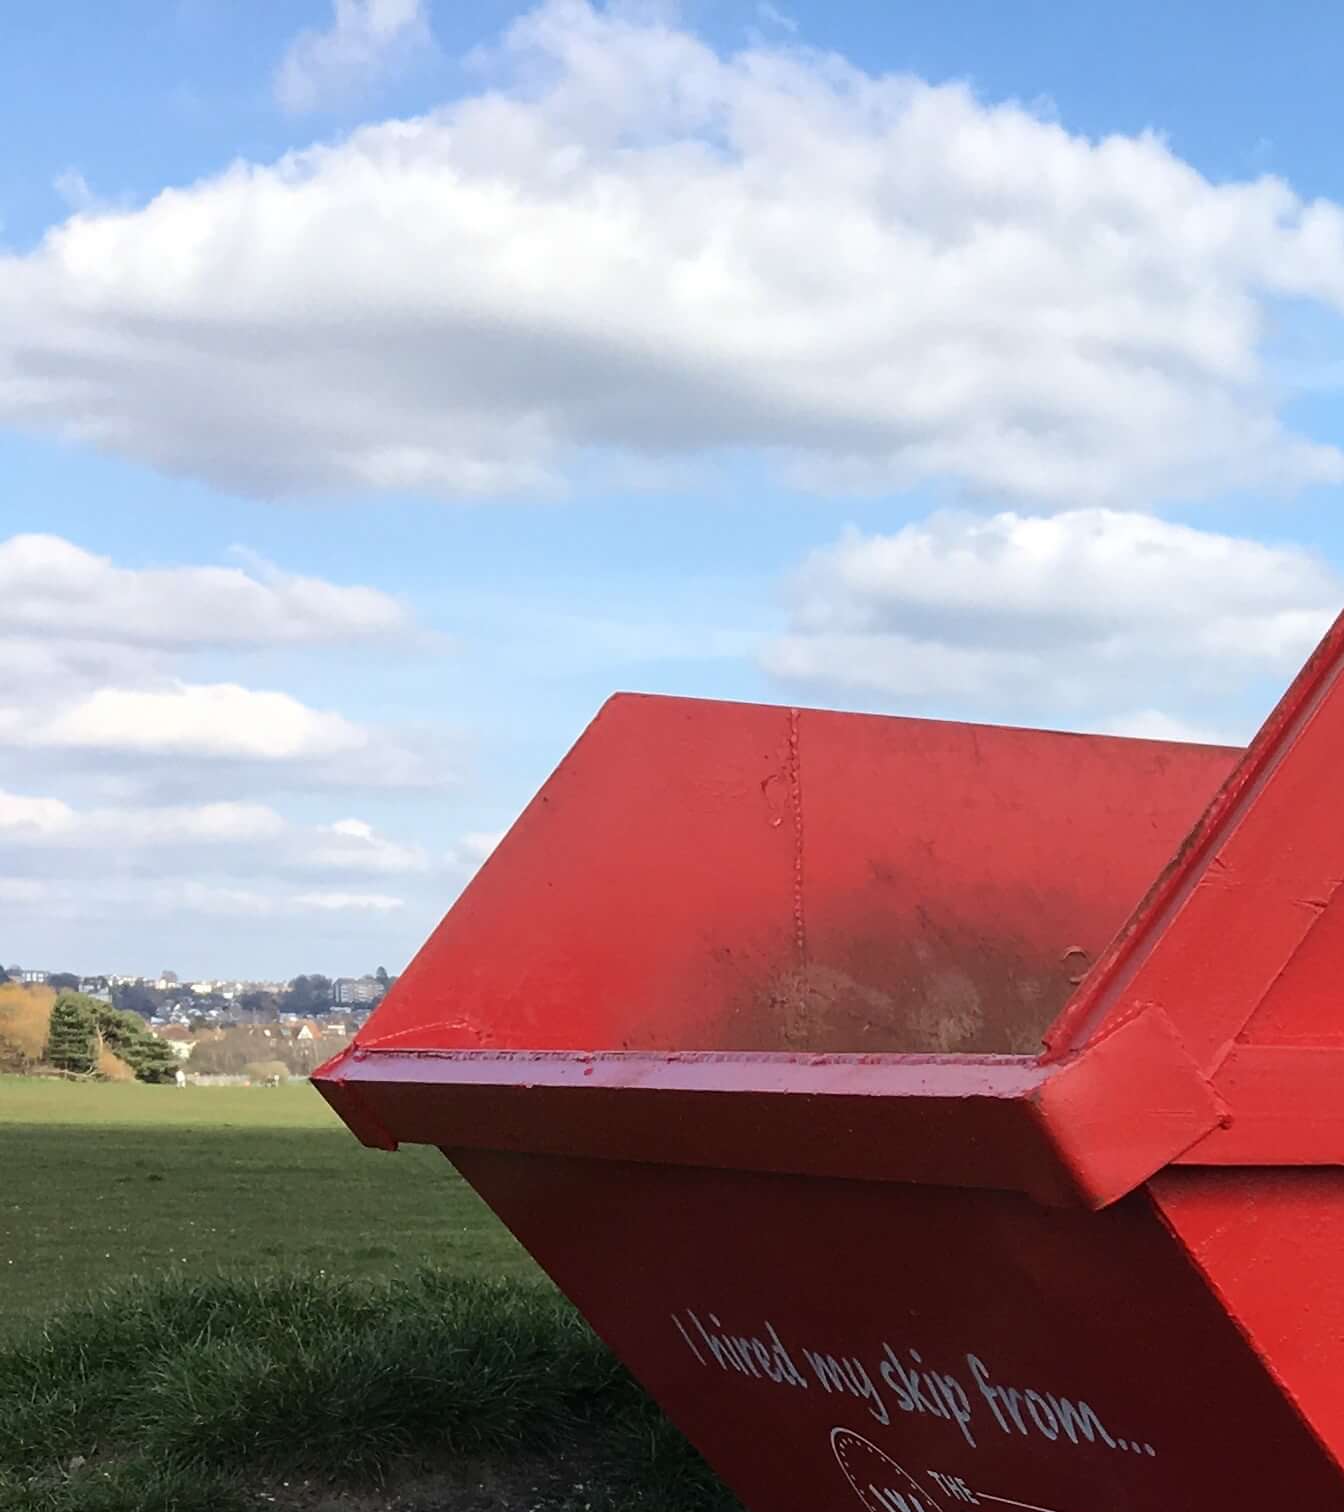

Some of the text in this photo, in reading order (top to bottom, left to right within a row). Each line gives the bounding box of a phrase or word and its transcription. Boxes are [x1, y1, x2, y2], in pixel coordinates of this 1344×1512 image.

[687, 1308, 808, 1389] hired
[802, 1347, 890, 1425] my
[880, 1342, 977, 1449] skip
[927, 1470, 980, 1505] THE
